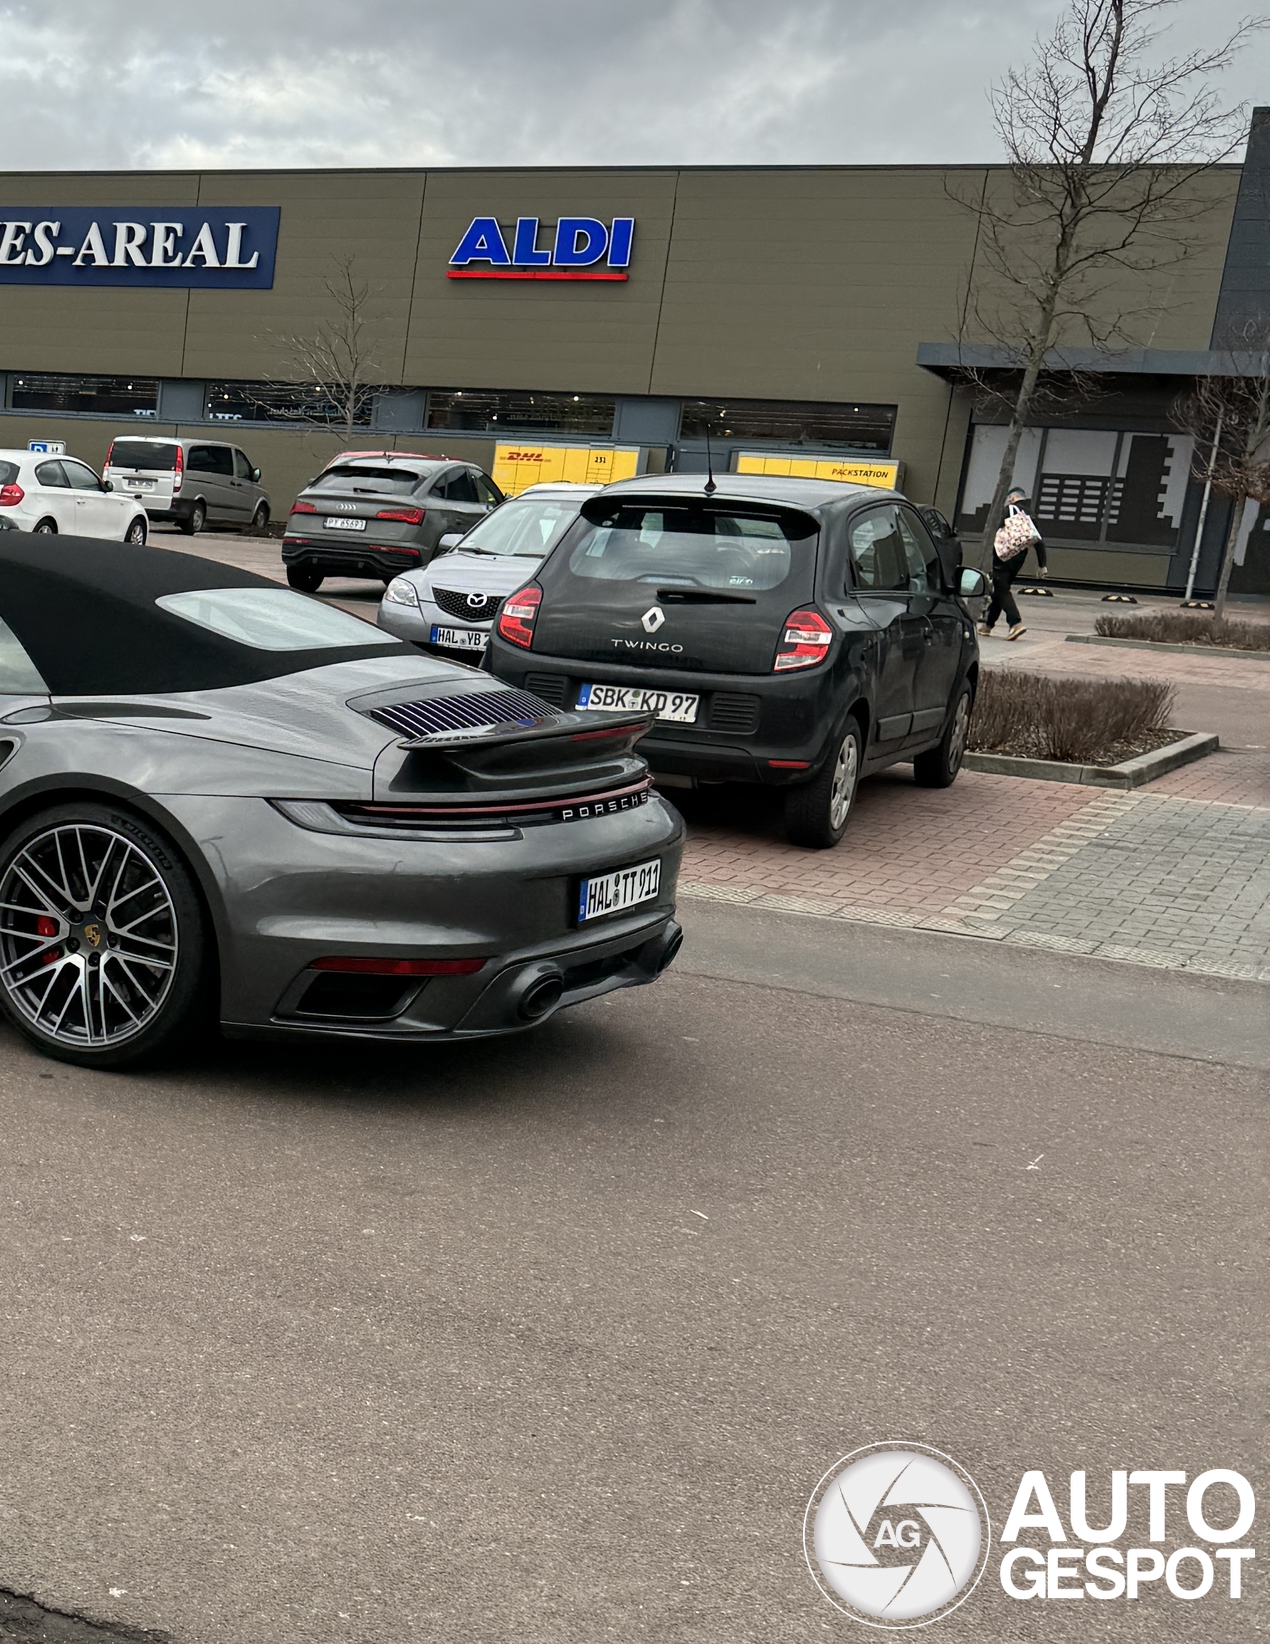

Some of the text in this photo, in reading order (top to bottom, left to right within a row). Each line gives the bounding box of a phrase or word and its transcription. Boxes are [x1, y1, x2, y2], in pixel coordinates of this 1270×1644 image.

[449, 216, 635, 267] ALDI
[506, 451, 544, 463] DHL
[831, 468, 889, 479] PACKSTATION
[438, 629, 458, 644] HAL
[467, 632, 481, 646] YB
[611, 639, 684, 653] TWINGO
[590, 687, 697, 715] SBK KD 97
[562, 791, 647, 821] PORSCHE
[588, 864, 659, 915] HAL TT 911
